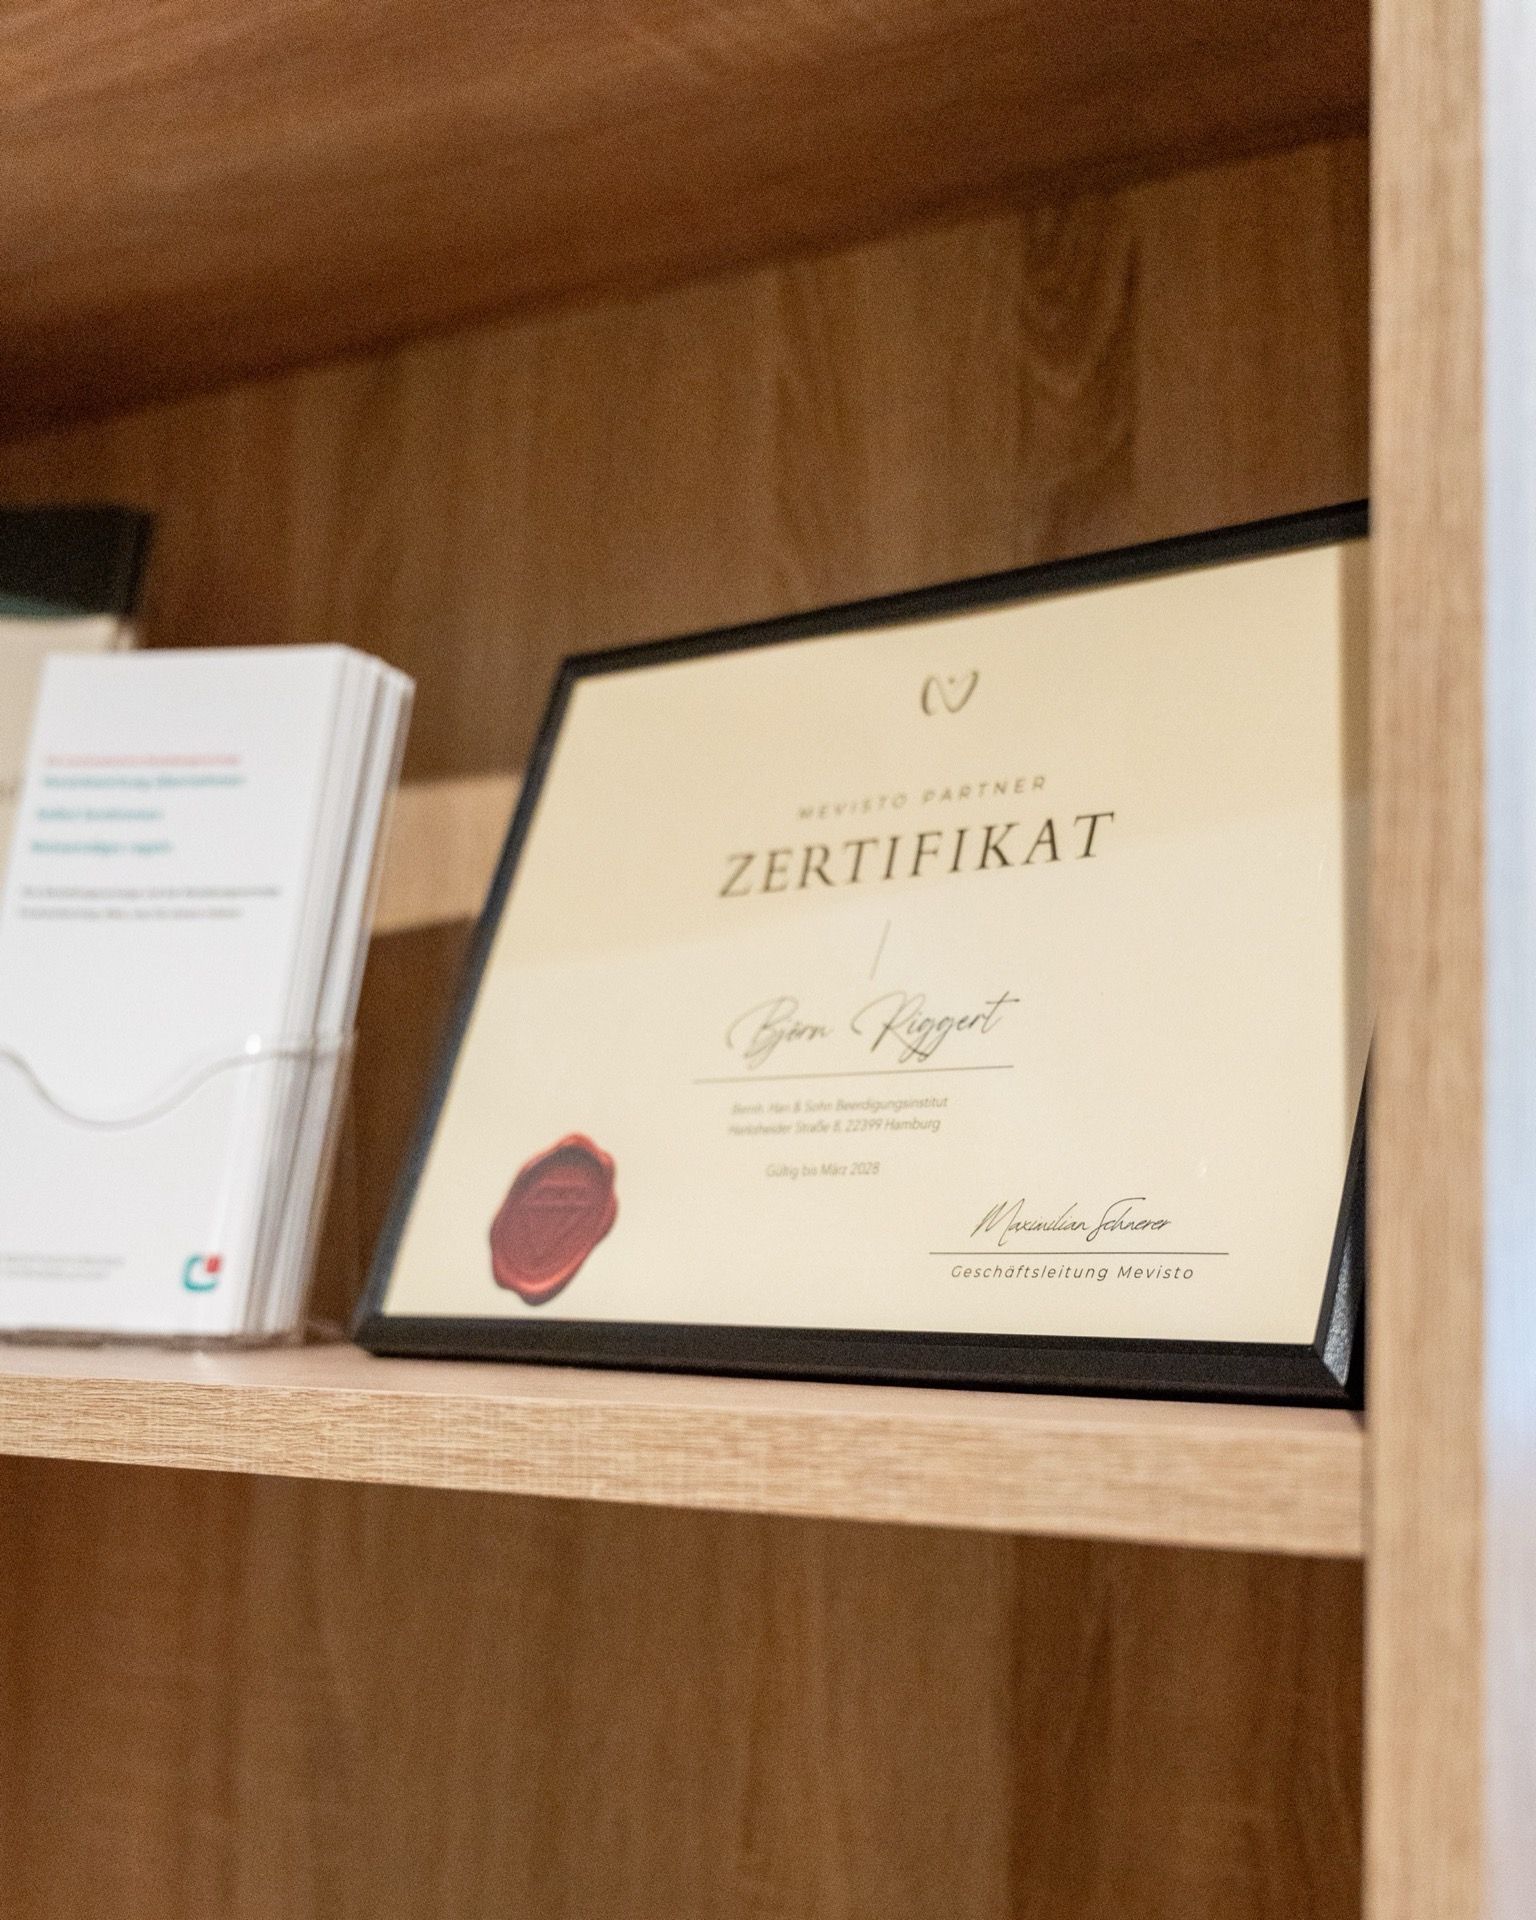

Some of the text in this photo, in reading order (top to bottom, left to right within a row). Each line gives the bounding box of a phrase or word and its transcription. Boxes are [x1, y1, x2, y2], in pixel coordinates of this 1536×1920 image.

[922, 775, 1047, 805] PARTNER
[719, 811, 1115, 898] ZERTIFIKAT
[851, 990, 1020, 1063] Riggert
[836, 1097, 948, 1113] Beerdigungsinstitut
[884, 1116, 941, 1133] Hamburg
[802, 1162, 818, 1176] bis
[820, 1161, 848, 1176] März
[951, 1264, 1194, 1281] Geschäftsleitung Mevisto
